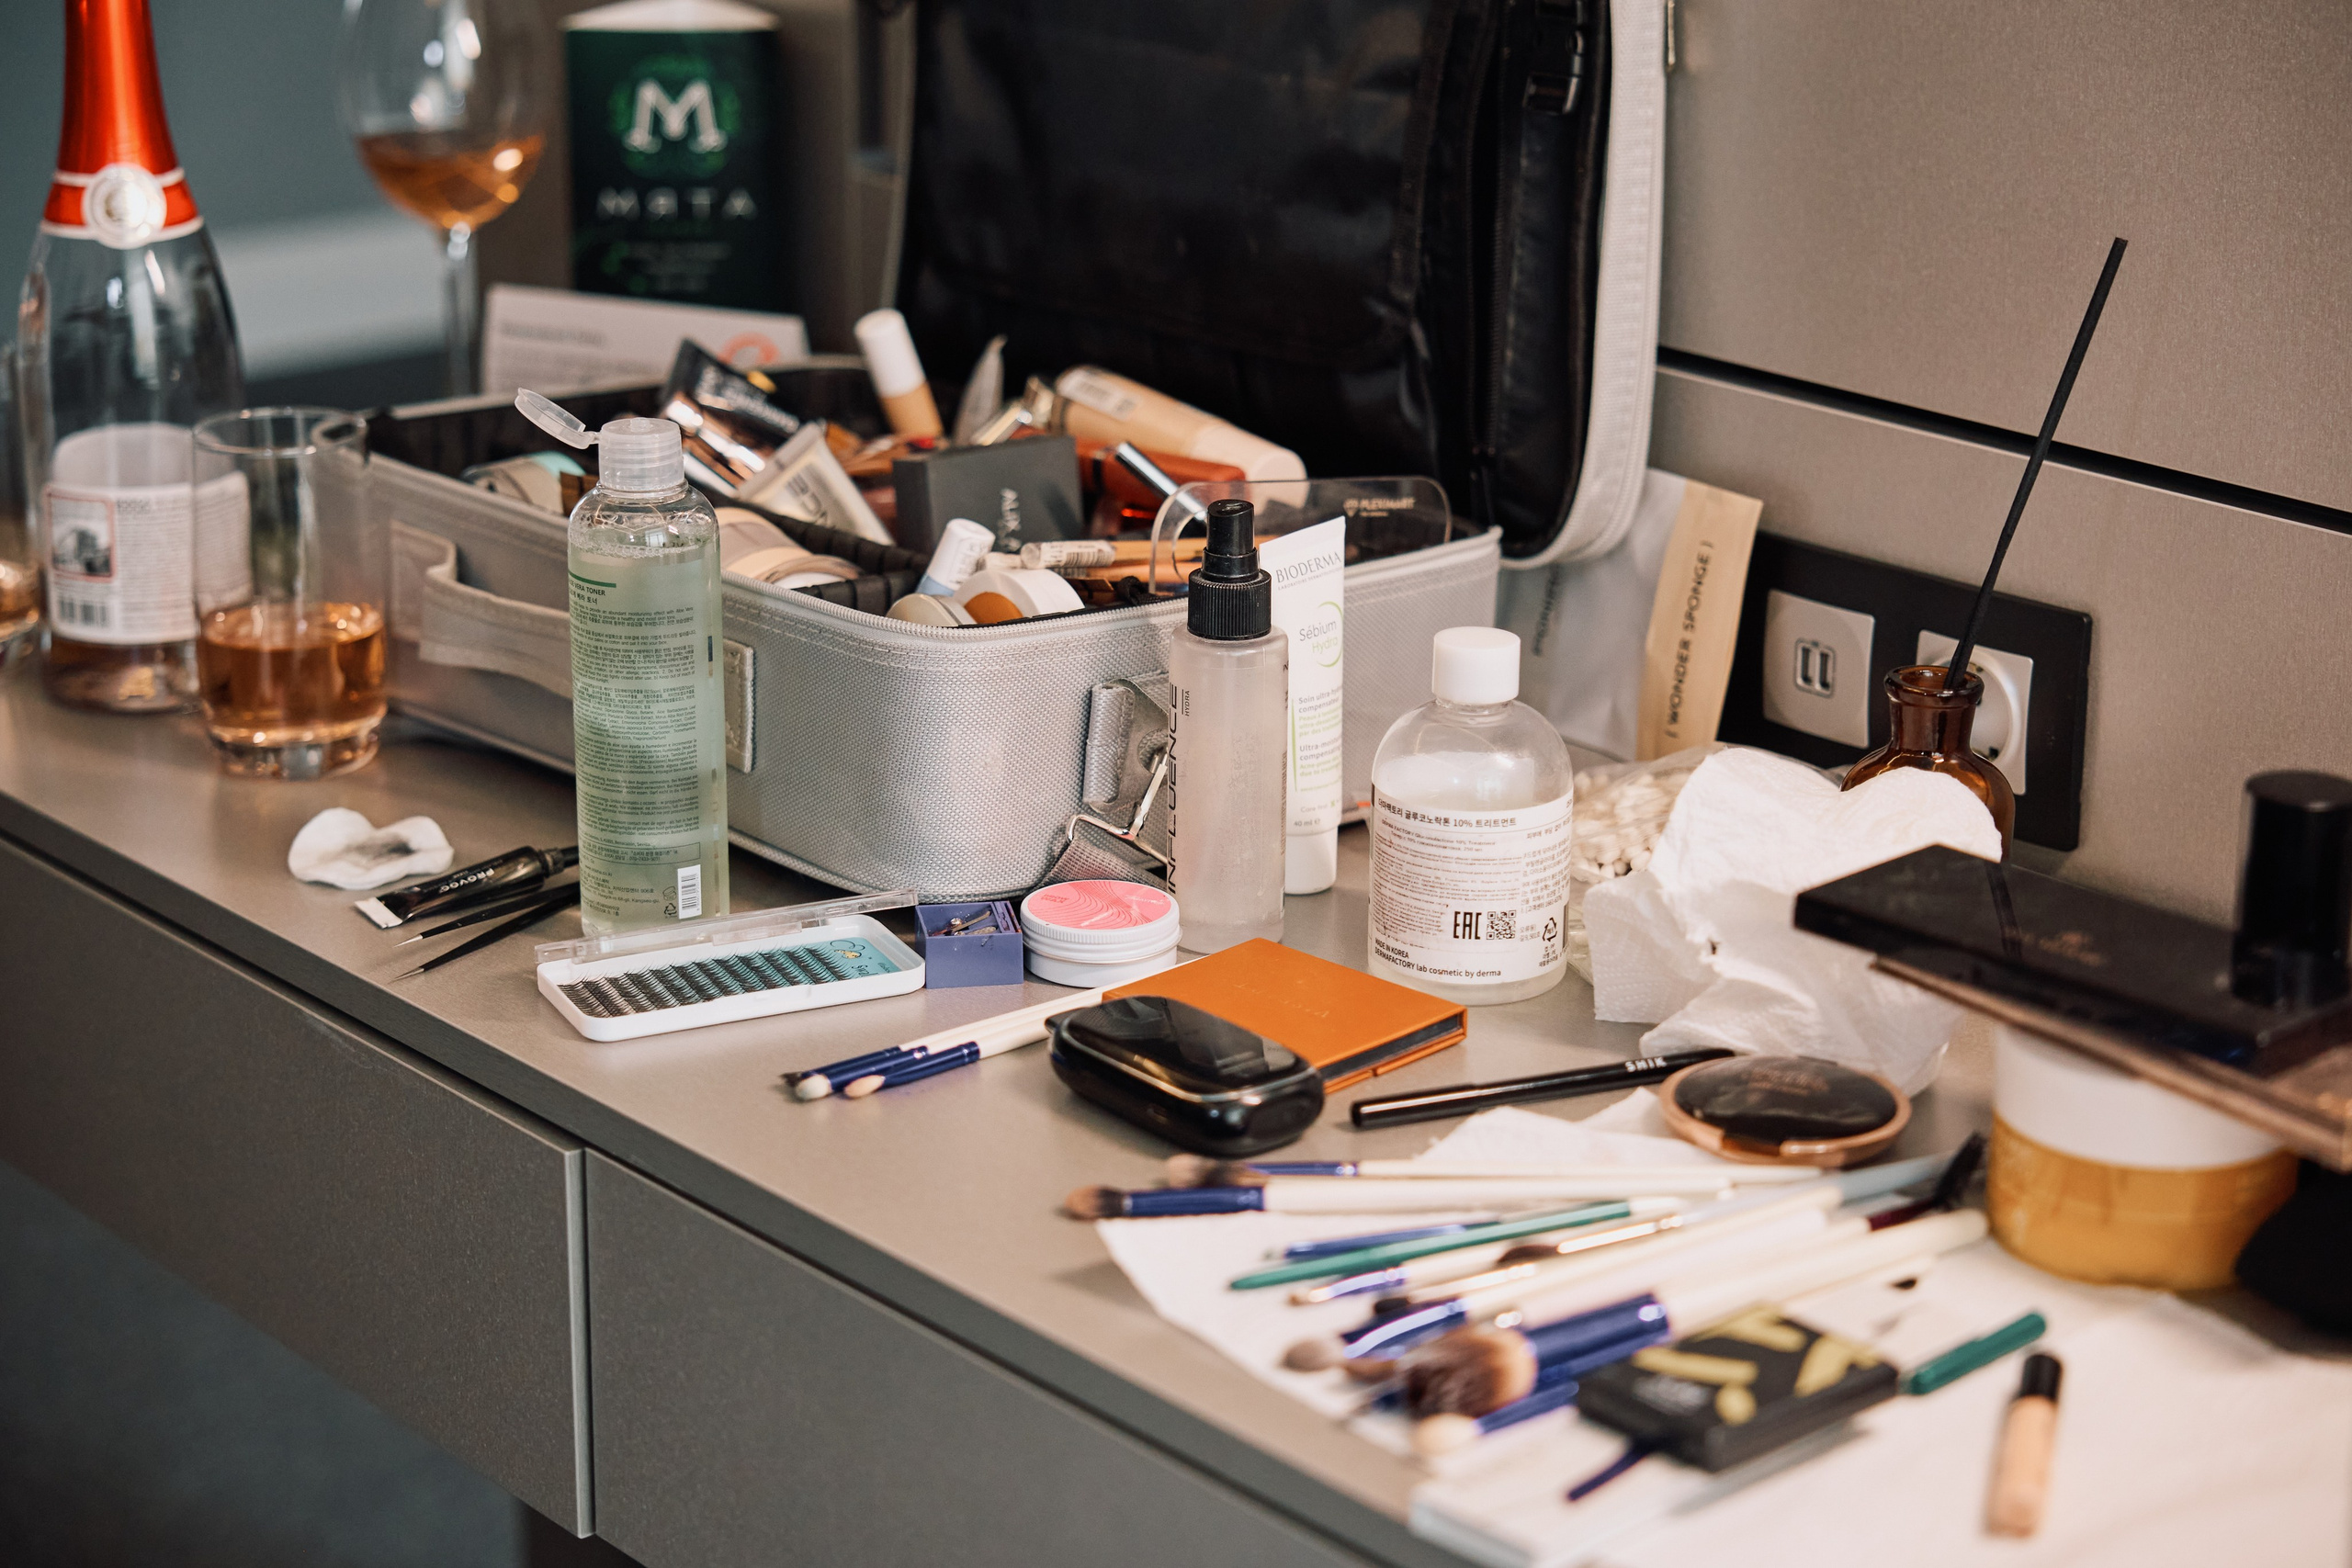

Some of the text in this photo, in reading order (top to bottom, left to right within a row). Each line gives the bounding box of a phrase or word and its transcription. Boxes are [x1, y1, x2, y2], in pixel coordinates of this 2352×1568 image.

[1276, 551, 1341, 583] BIODERMA
[586, 586, 605, 595] TONER
[1299, 621, 1337, 641] Sébium
[1668, 638, 1690, 725] WONDER
[1683, 550, 1710, 633] SPONGE
[1312, 636, 1338, 654] Hydro
[1299, 695, 1315, 704] Soin
[1169, 682, 1178, 894] INFLUENCE
[1453, 819, 1474, 828] 10%
[1476, 818, 1516, 828] 트리트먼트
[1374, 937, 1409, 959] MADE IN KOREA
[1374, 947, 1415, 969] DERMAFACTORY
[1429, 967, 1463, 976] cosmetic
[1464, 970, 1474, 978] by
[1625, 1056, 1668, 1073] SHIK
